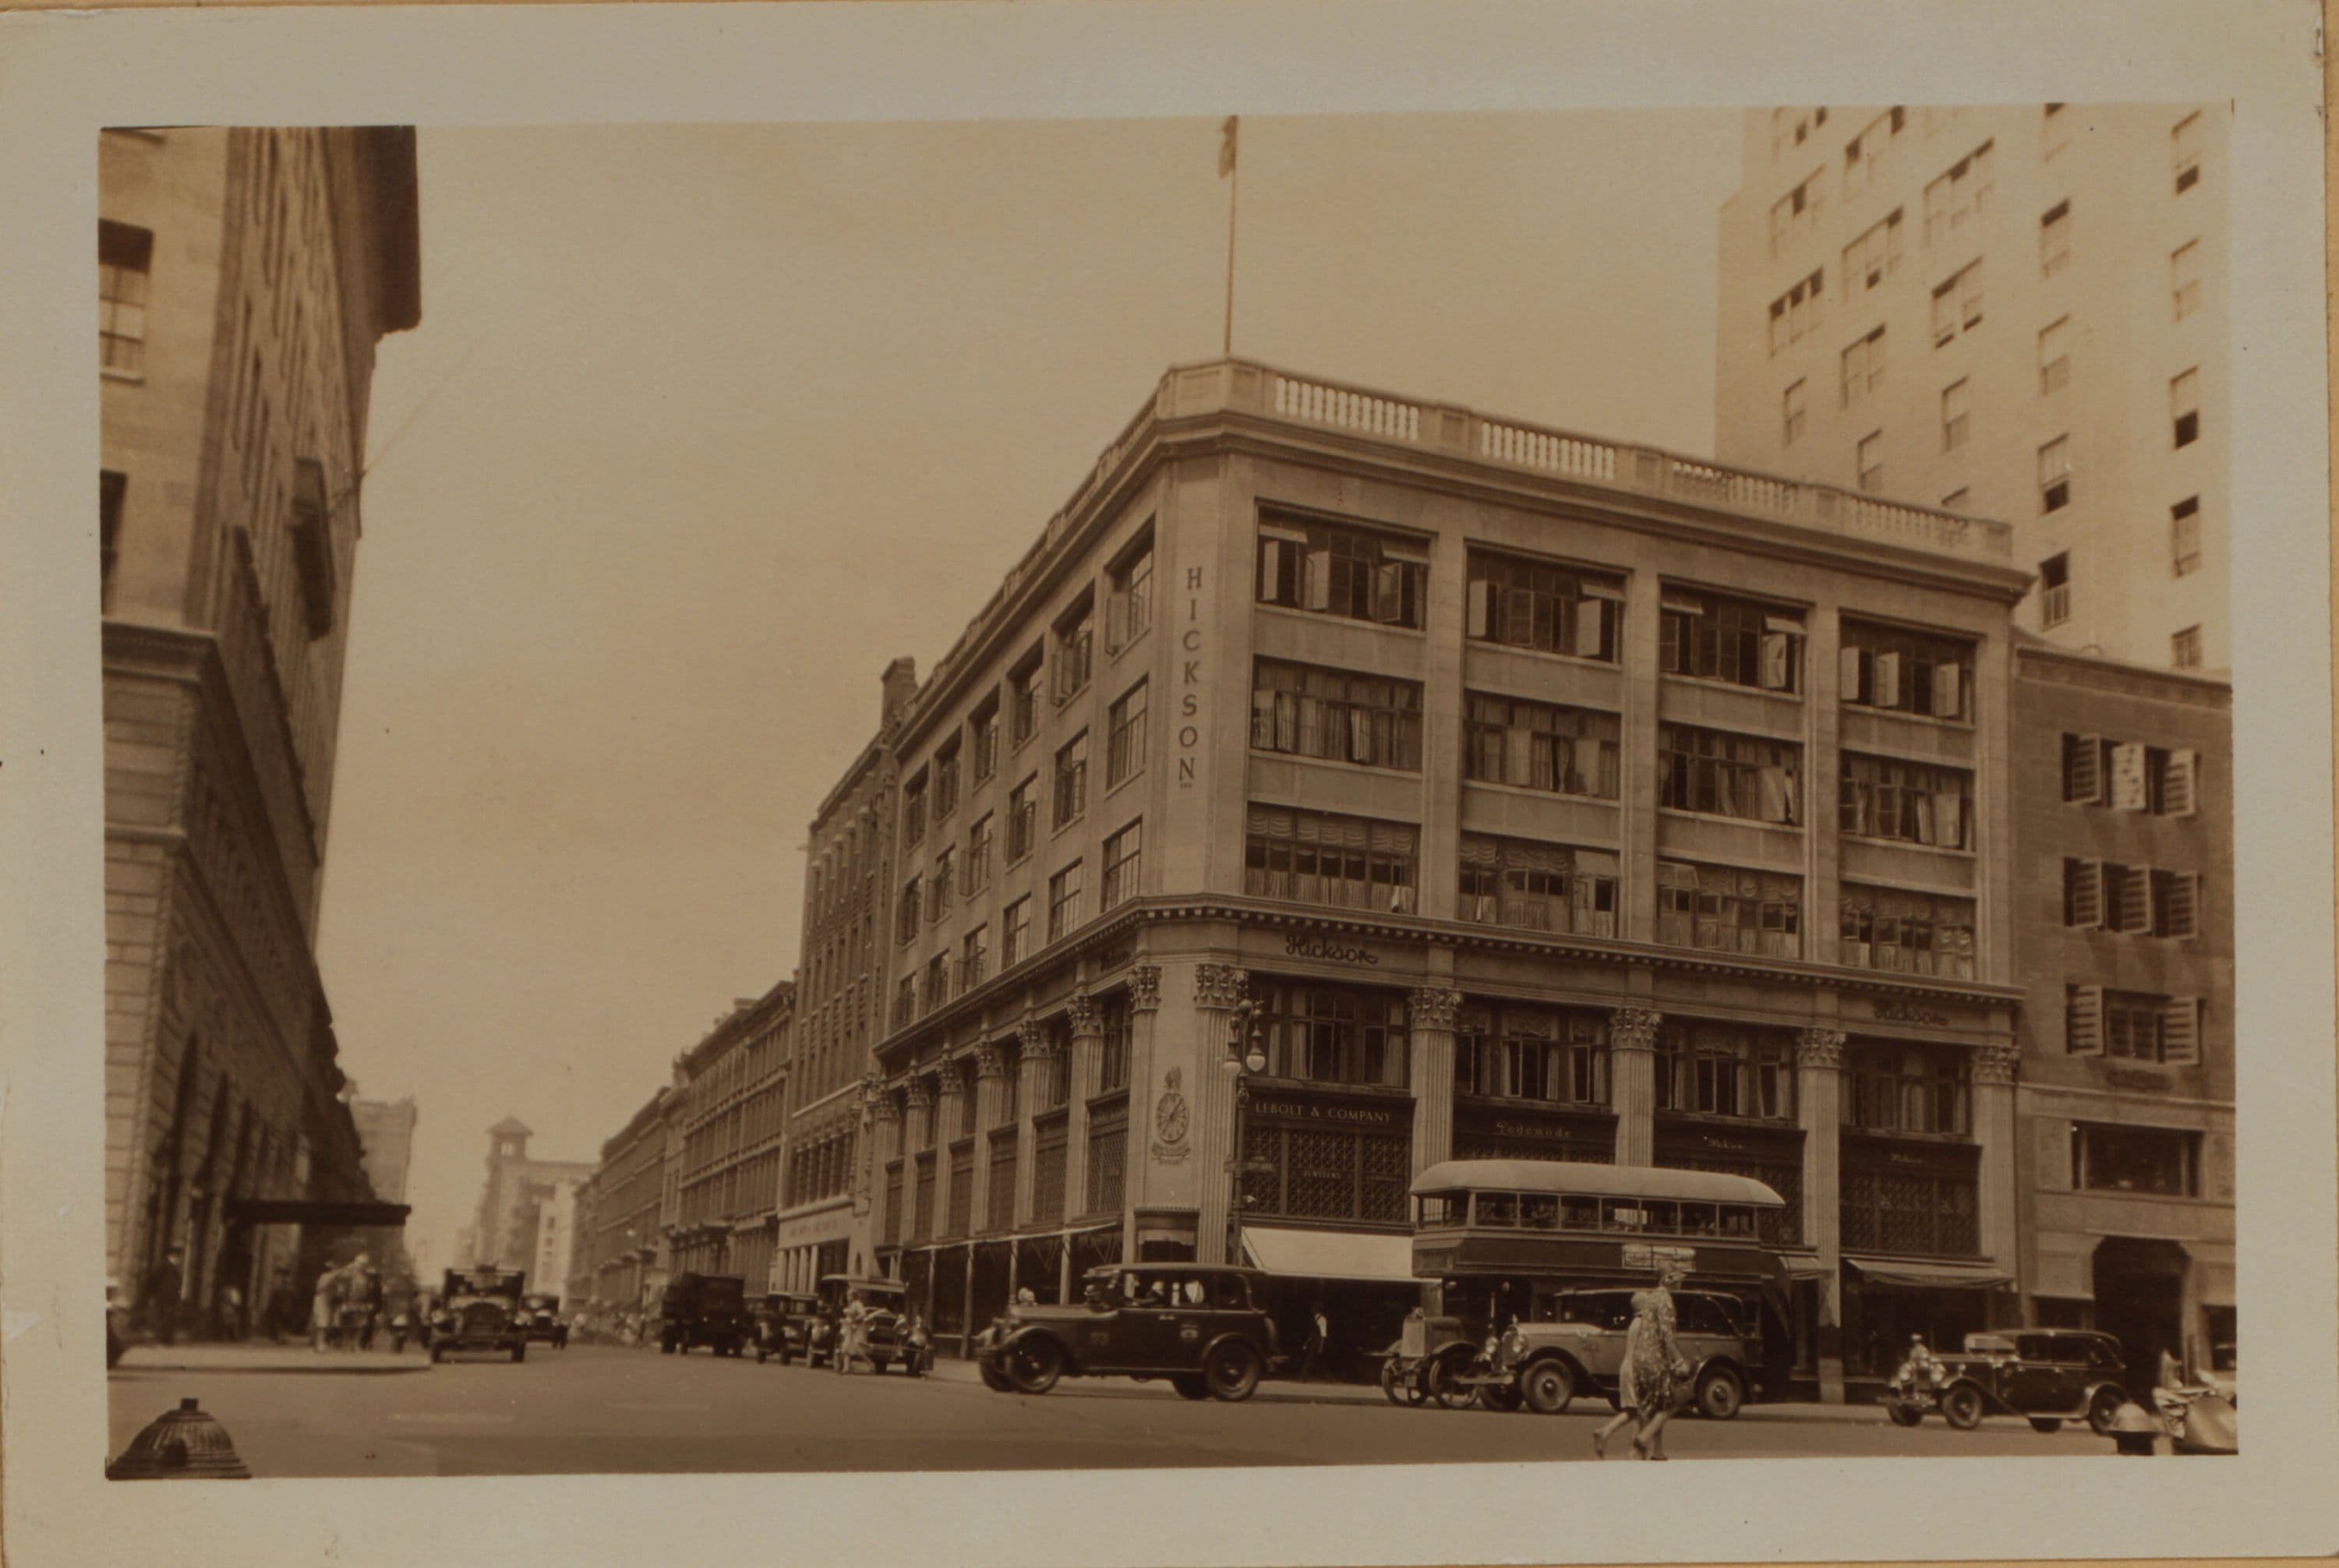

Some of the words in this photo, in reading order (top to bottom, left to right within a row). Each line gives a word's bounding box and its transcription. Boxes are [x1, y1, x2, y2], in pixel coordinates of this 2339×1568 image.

[1178, 566, 1203, 782] HICKSON
[1285, 931, 1379, 964] Hickson
[1255, 1102, 1303, 1117] LEBOLT
[1310, 1105, 1321, 1118] &
[1327, 1107, 1391, 1123] COMPANY
